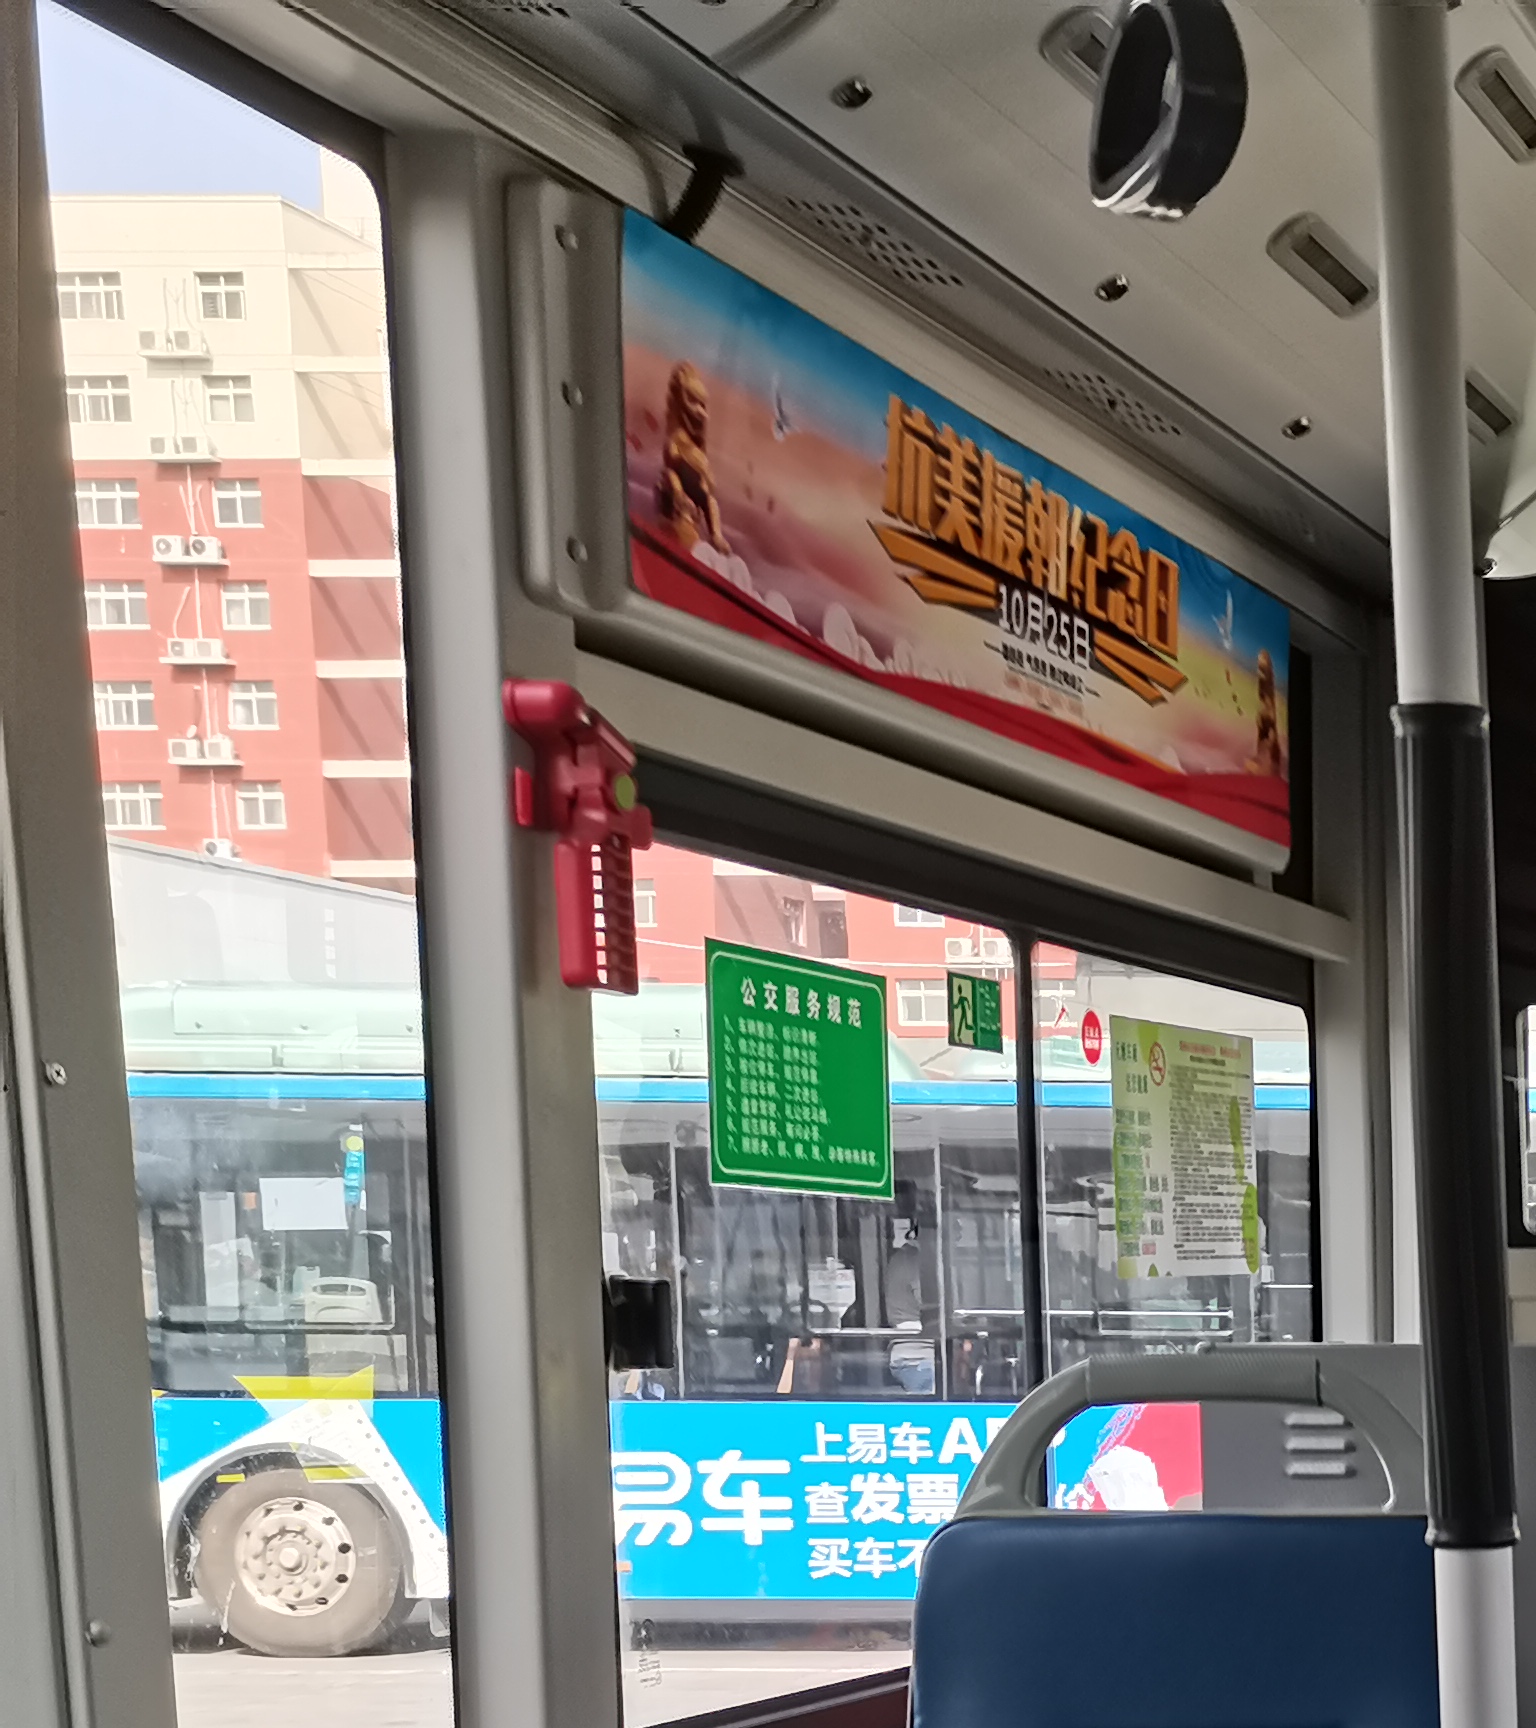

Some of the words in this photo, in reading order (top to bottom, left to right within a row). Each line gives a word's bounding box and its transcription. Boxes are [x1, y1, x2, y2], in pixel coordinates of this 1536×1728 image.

[882, 391, 1180, 662] 抗美援朝纪念日
[998, 583, 1092, 672] 10月25日
[740, 976, 862, 1029] 公交服务规范
[612, 1450, 794, 1547] 易车
[804, 1472, 959, 1525] 查发票
